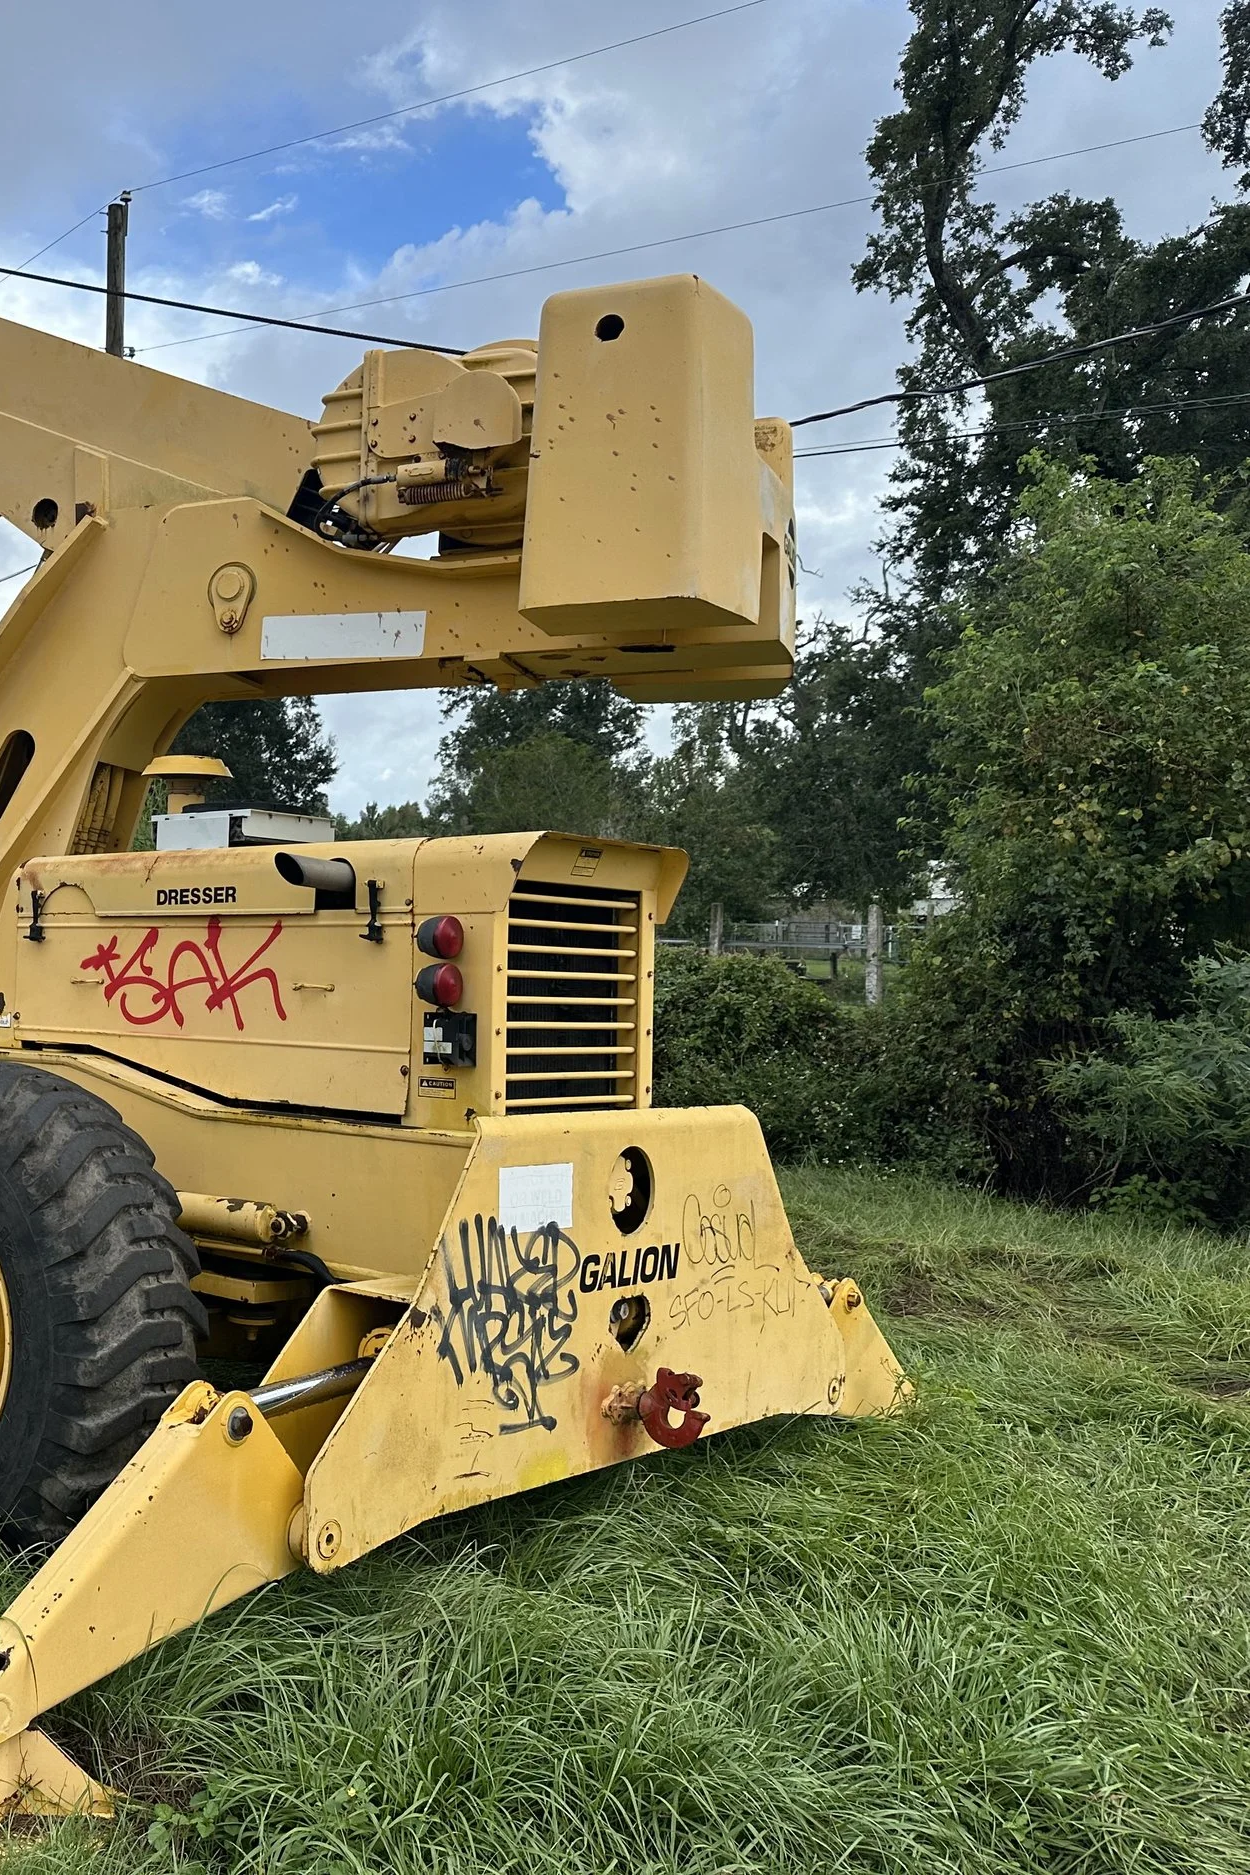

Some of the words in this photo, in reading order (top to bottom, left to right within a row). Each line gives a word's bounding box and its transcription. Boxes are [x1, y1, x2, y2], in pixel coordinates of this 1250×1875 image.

[156, 885, 237, 906] DRESSER
[428, 1080, 453, 1088] CAUTION
[579, 1242, 680, 1294] GALION
